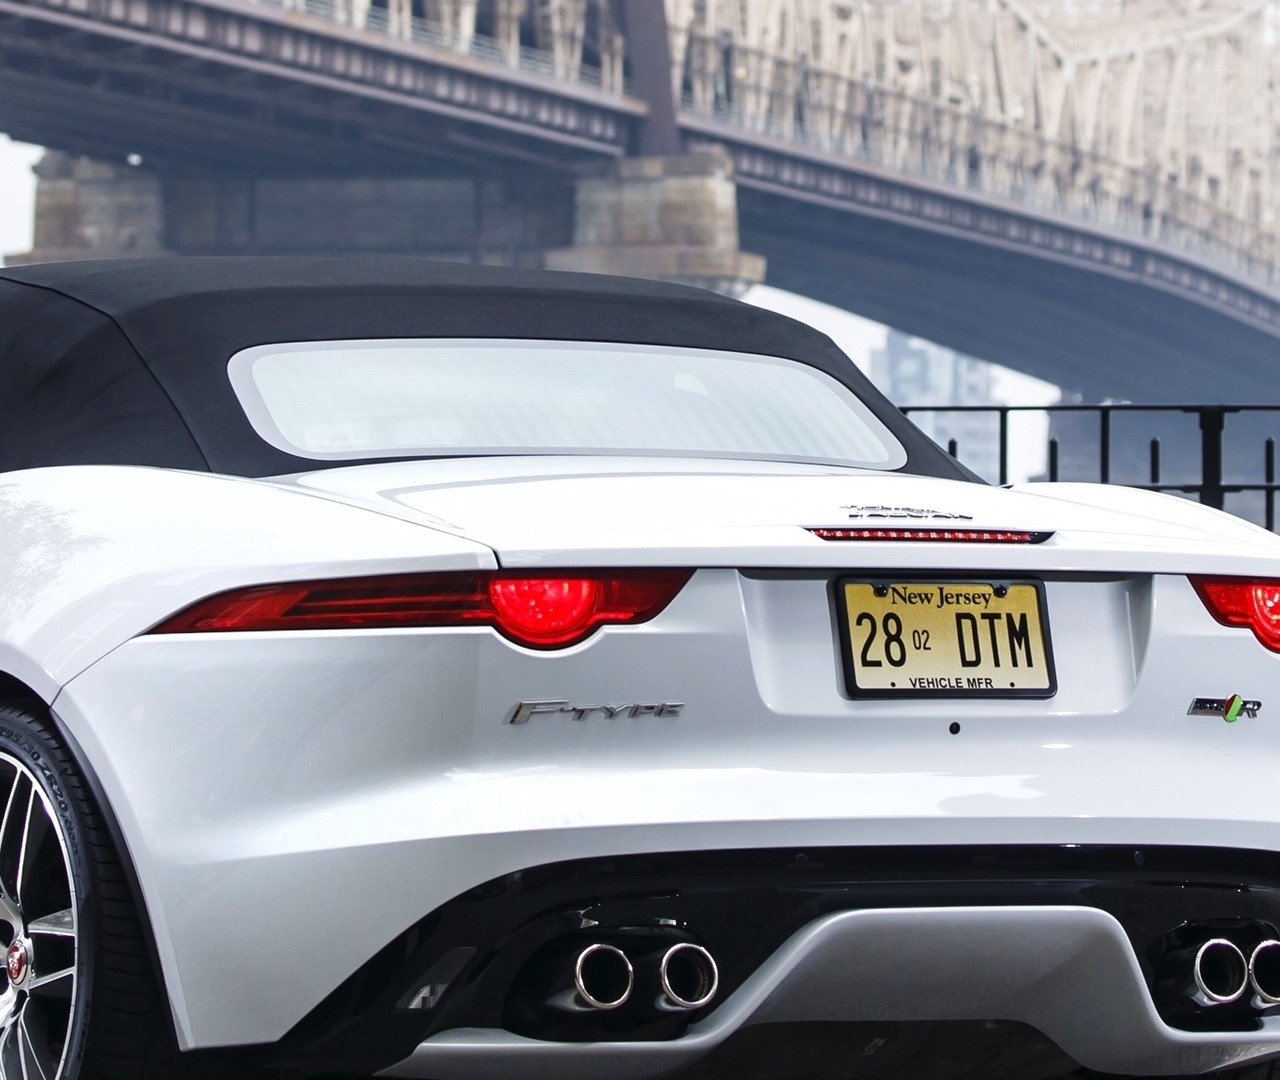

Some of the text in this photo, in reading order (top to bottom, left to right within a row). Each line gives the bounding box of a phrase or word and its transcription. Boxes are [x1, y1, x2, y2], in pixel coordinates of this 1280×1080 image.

[890, 586, 992, 609] New Jersey
[855, 611, 1034, 668] 28 02 DTM
[908, 677, 995, 689] VEHICLE MFR
[508, 698, 686, 724] F-TYPE
